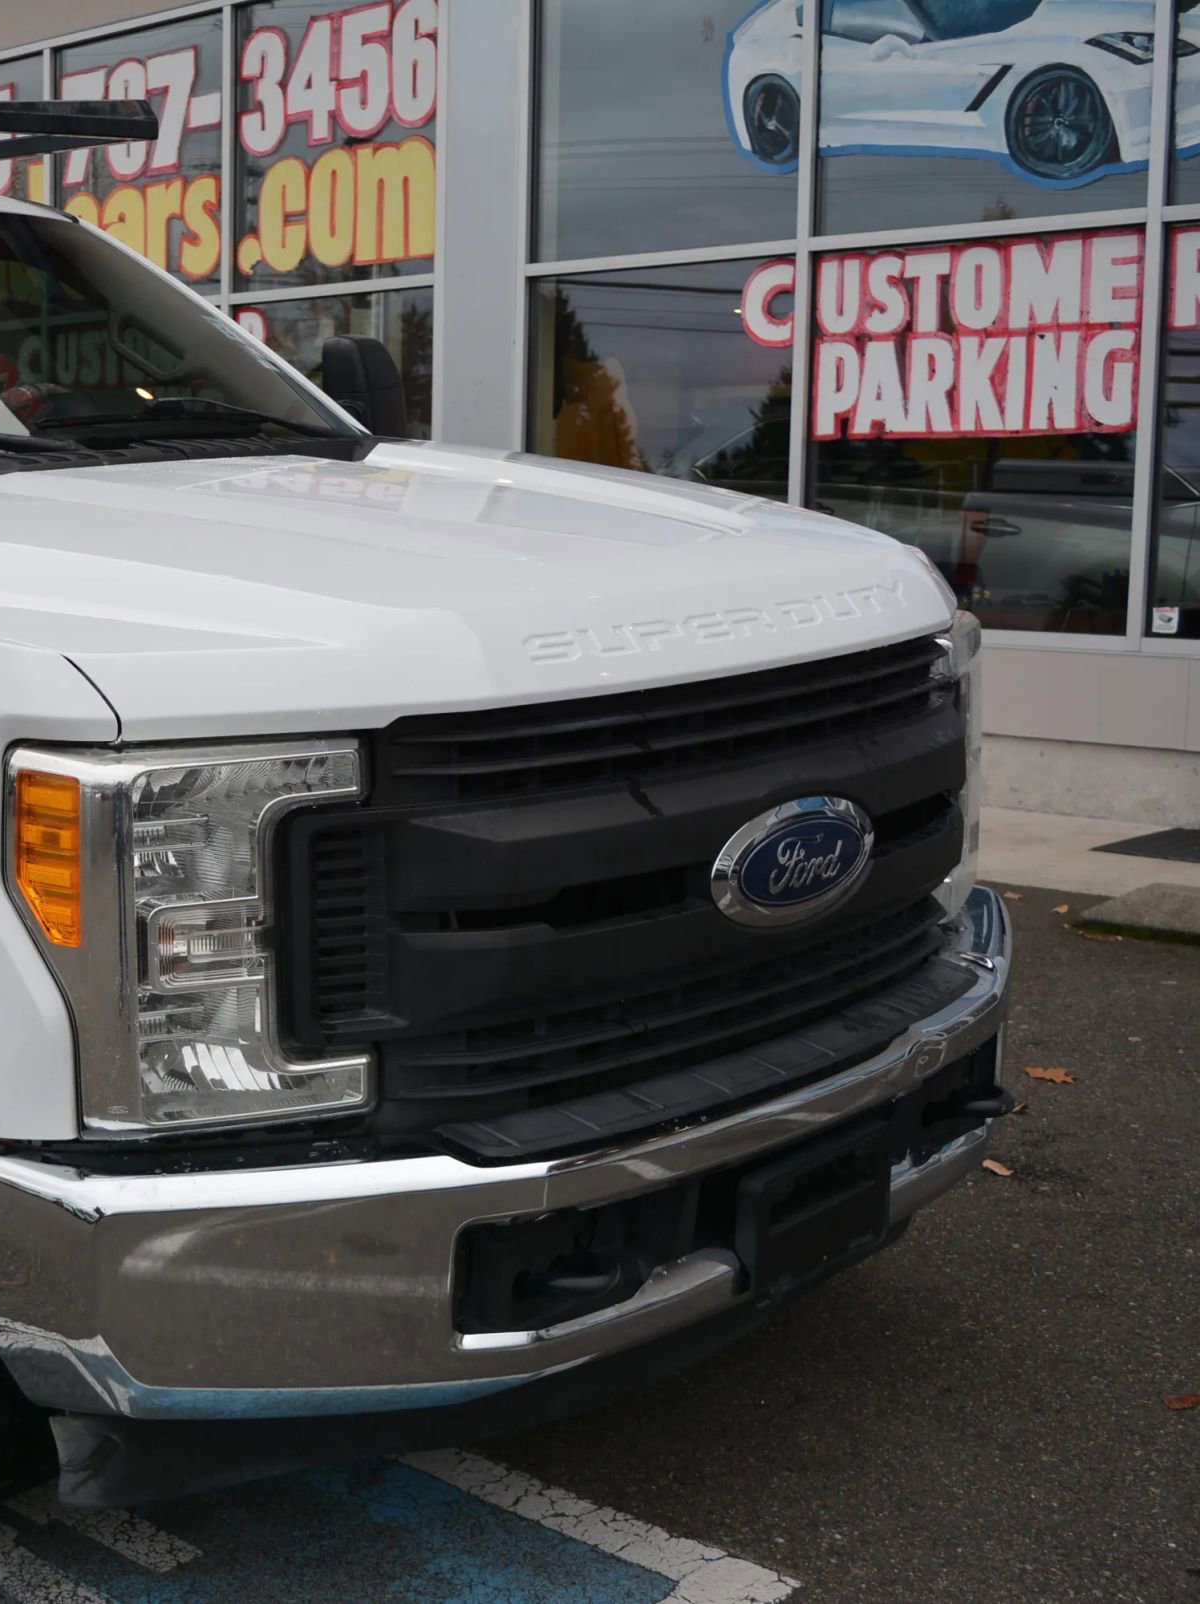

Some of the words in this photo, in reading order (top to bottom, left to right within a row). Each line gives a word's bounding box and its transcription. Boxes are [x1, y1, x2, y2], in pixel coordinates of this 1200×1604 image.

[812, 328, 1140, 441] PARKING
[521, 605, 777, 666] SUPER
[776, 580, 907, 630] DUTY
[767, 831, 844, 895] Ford
